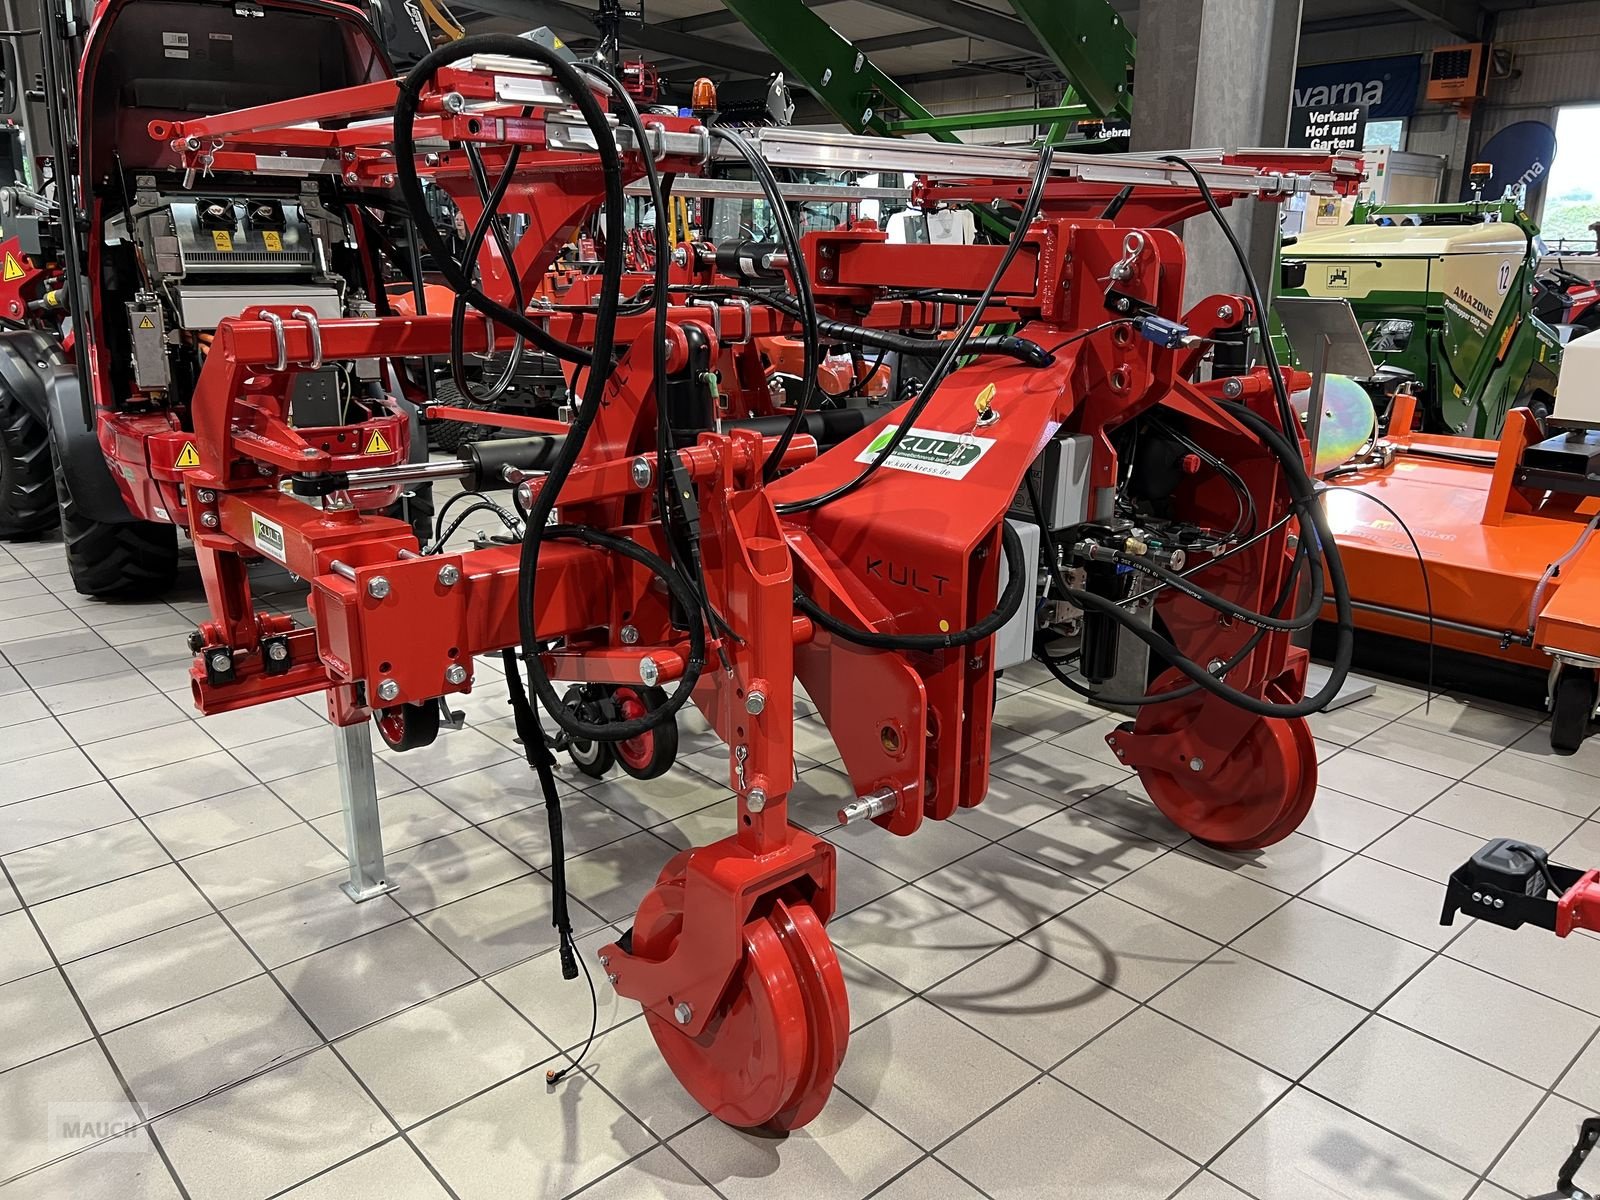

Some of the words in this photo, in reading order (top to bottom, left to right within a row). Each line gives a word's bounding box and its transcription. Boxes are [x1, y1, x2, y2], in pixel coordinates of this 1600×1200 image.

[1294, 80, 1384, 107] varna
[1309, 109, 1360, 123] Verkauf
[1305, 124, 1330, 138] Hof
[1331, 123, 1357, 136] und
[1310, 138, 1355, 150] Garten
[1499, 265, 1510, 289] 12
[1453, 286, 1494, 320] AMAZONE
[866, 555, 950, 597] KULT
